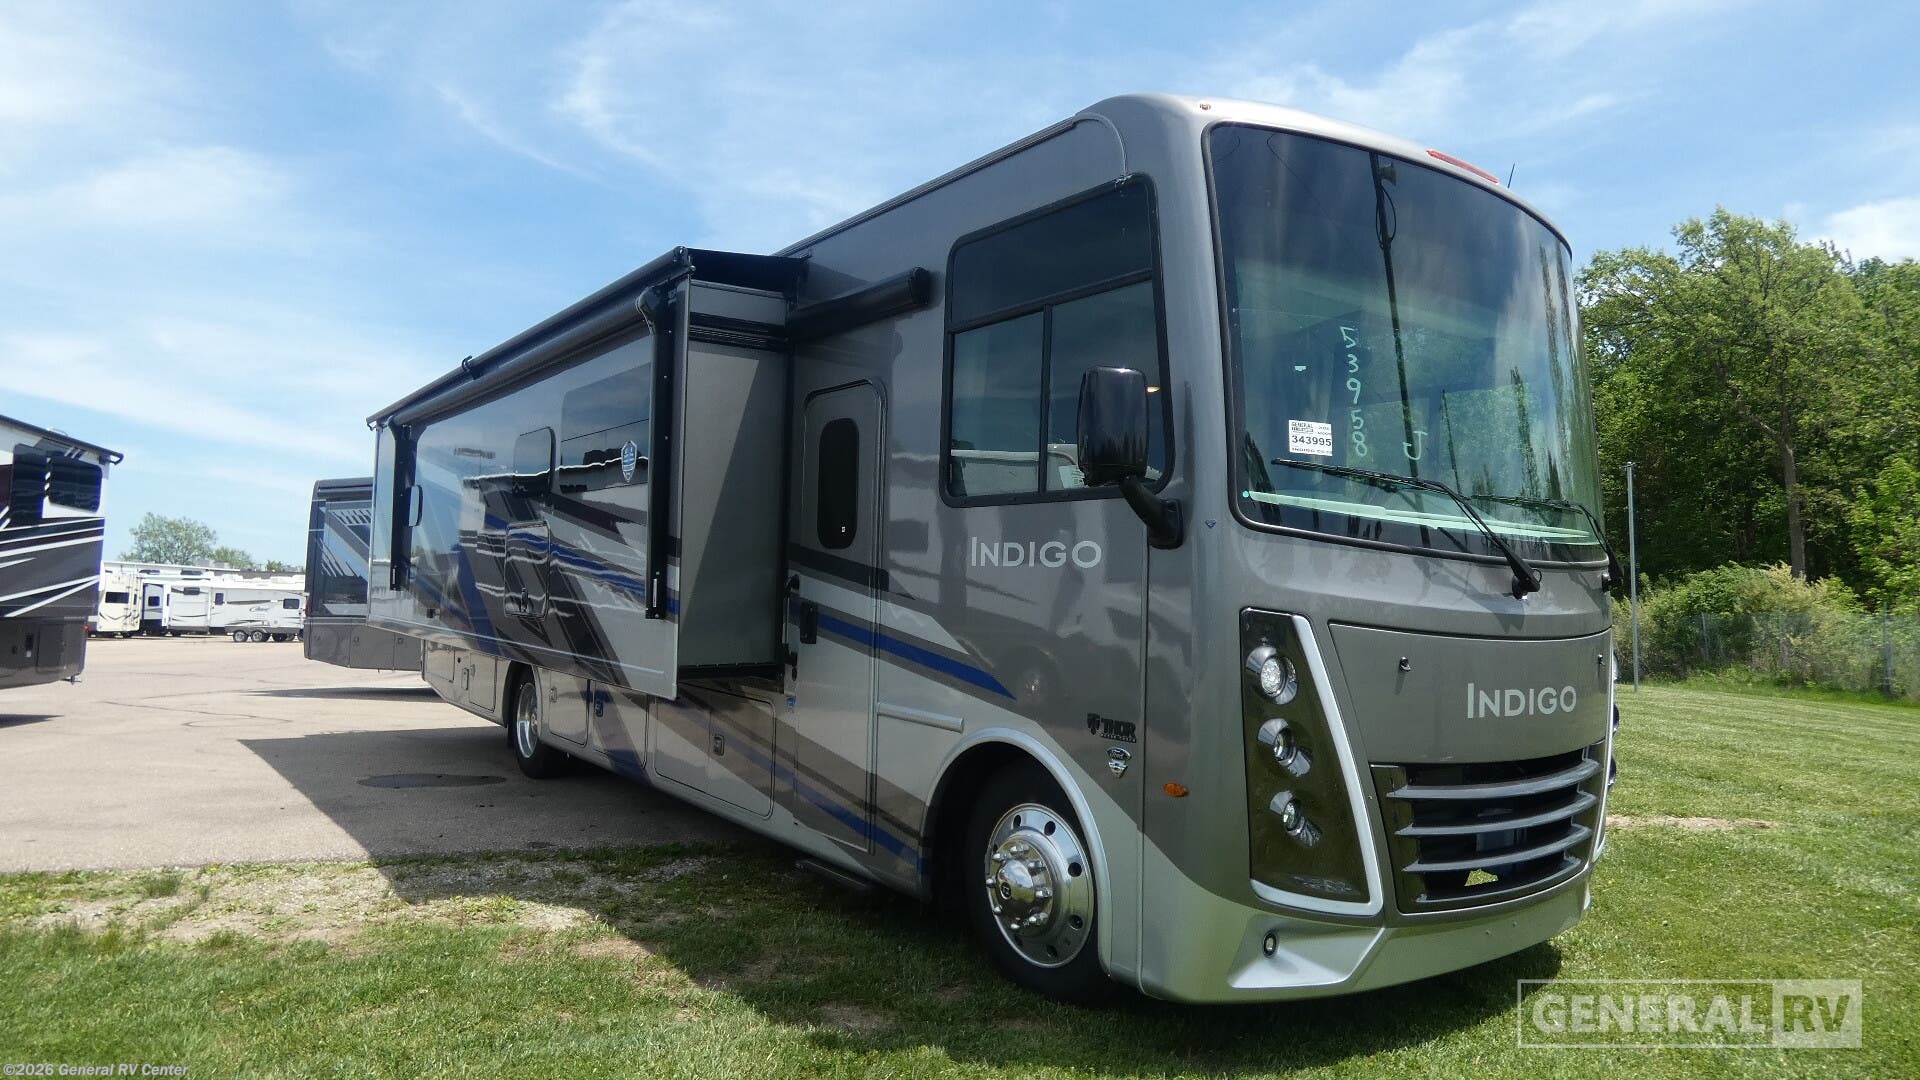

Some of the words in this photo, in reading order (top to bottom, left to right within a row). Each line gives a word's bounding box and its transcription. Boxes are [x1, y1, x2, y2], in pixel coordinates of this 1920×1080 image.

[1291, 435, 1331, 446] 343995
[971, 536, 1102, 568] INDIGO
[1467, 683, 1576, 718] INDIGO
